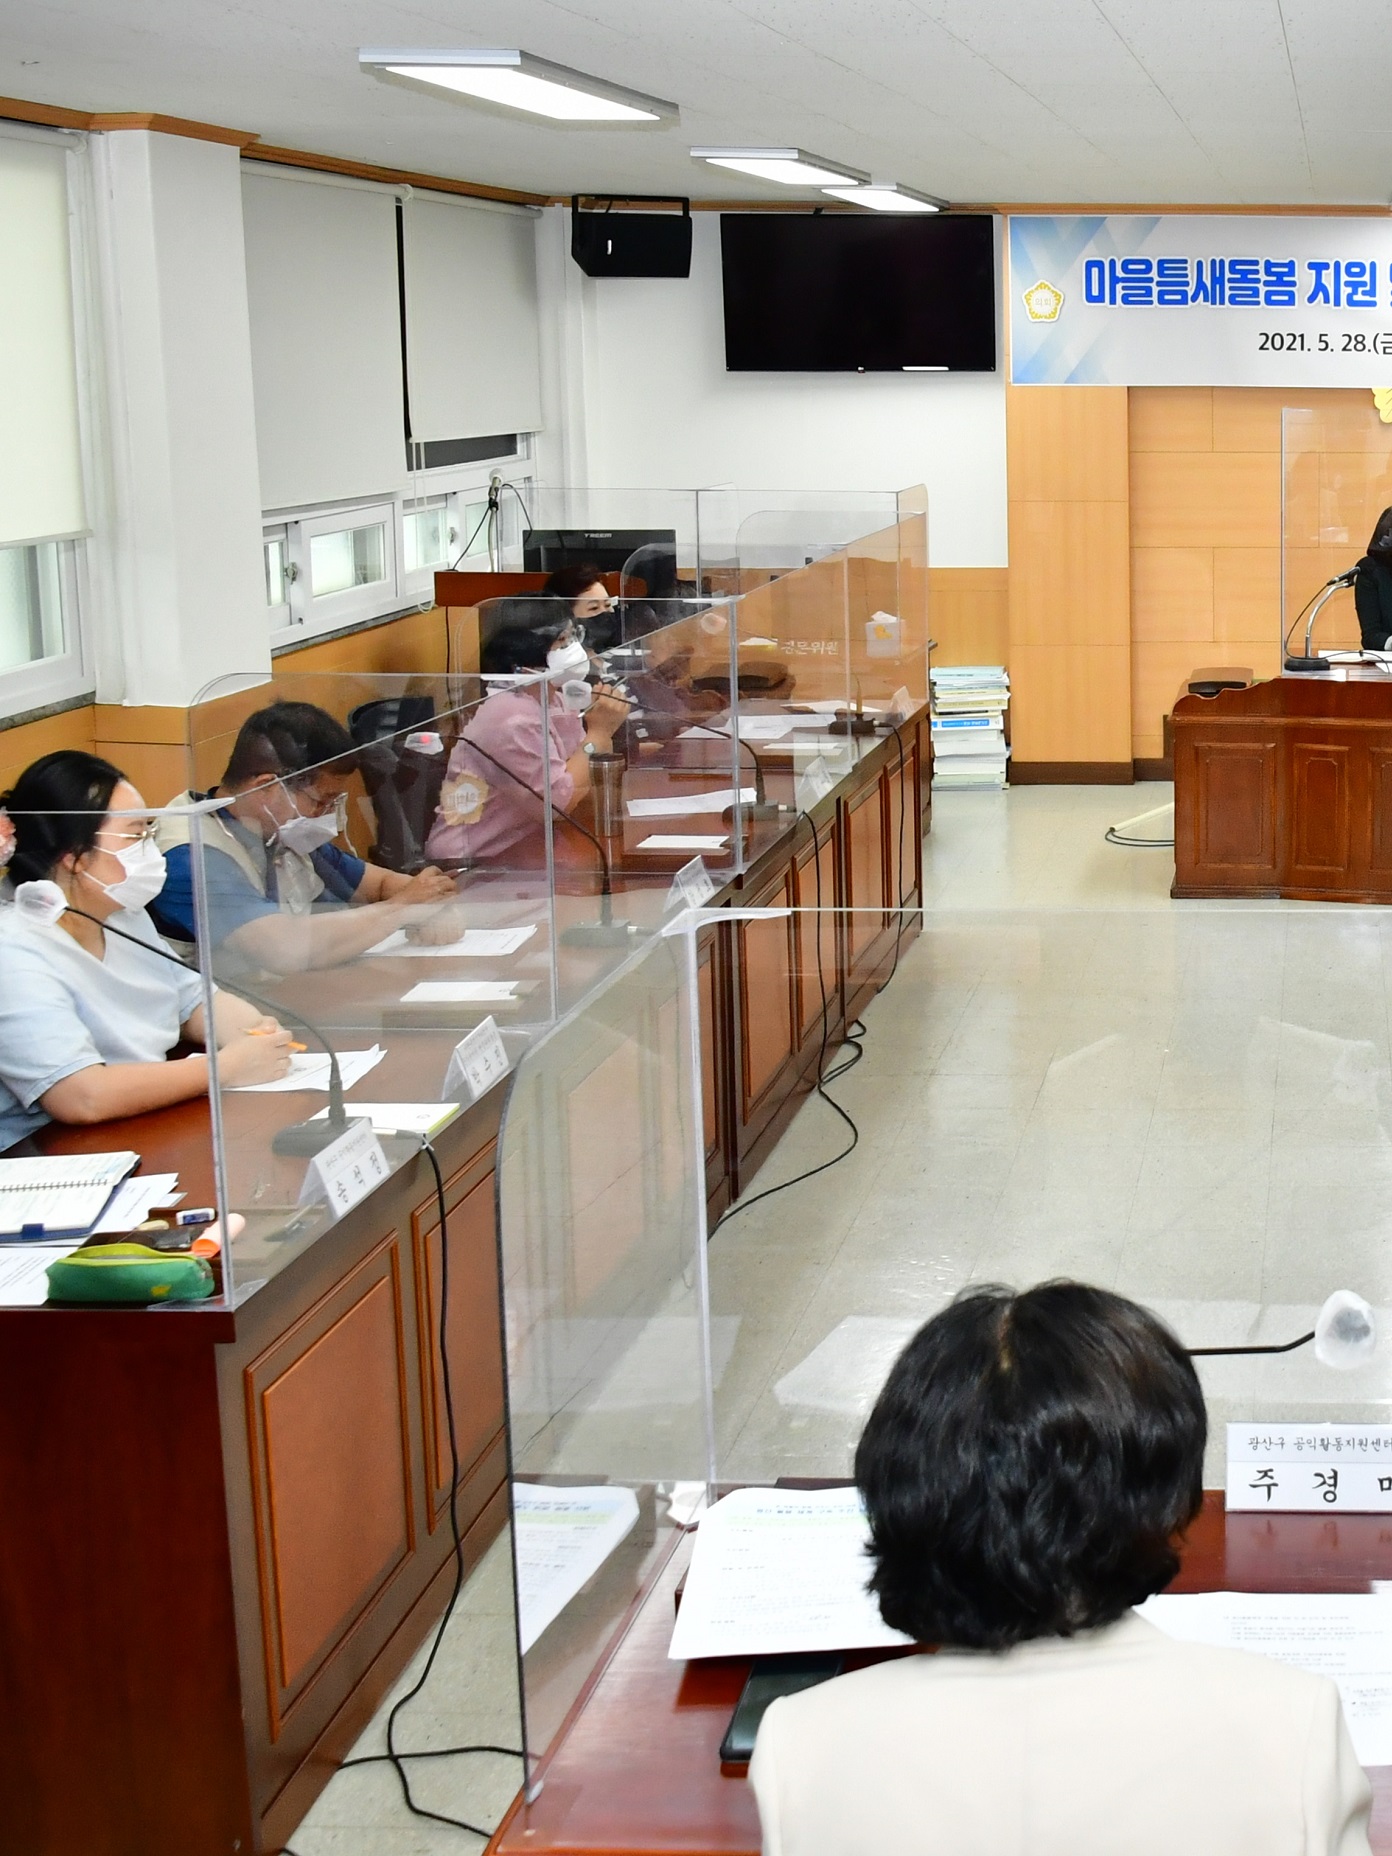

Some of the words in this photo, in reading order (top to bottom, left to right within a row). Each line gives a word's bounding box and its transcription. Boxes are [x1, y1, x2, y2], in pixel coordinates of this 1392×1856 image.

[1085, 258, 1297, 307] 마을틈새돌봄
[1306, 260, 1377, 307] 지원
[1258, 332, 1311, 352] 2021.
[1318, 333, 1335, 352] 5.
[1248, 1437, 1286, 1451] 광산구
[1248, 1468, 1279, 1502] 주
[1312, 1468, 1339, 1503] 경
